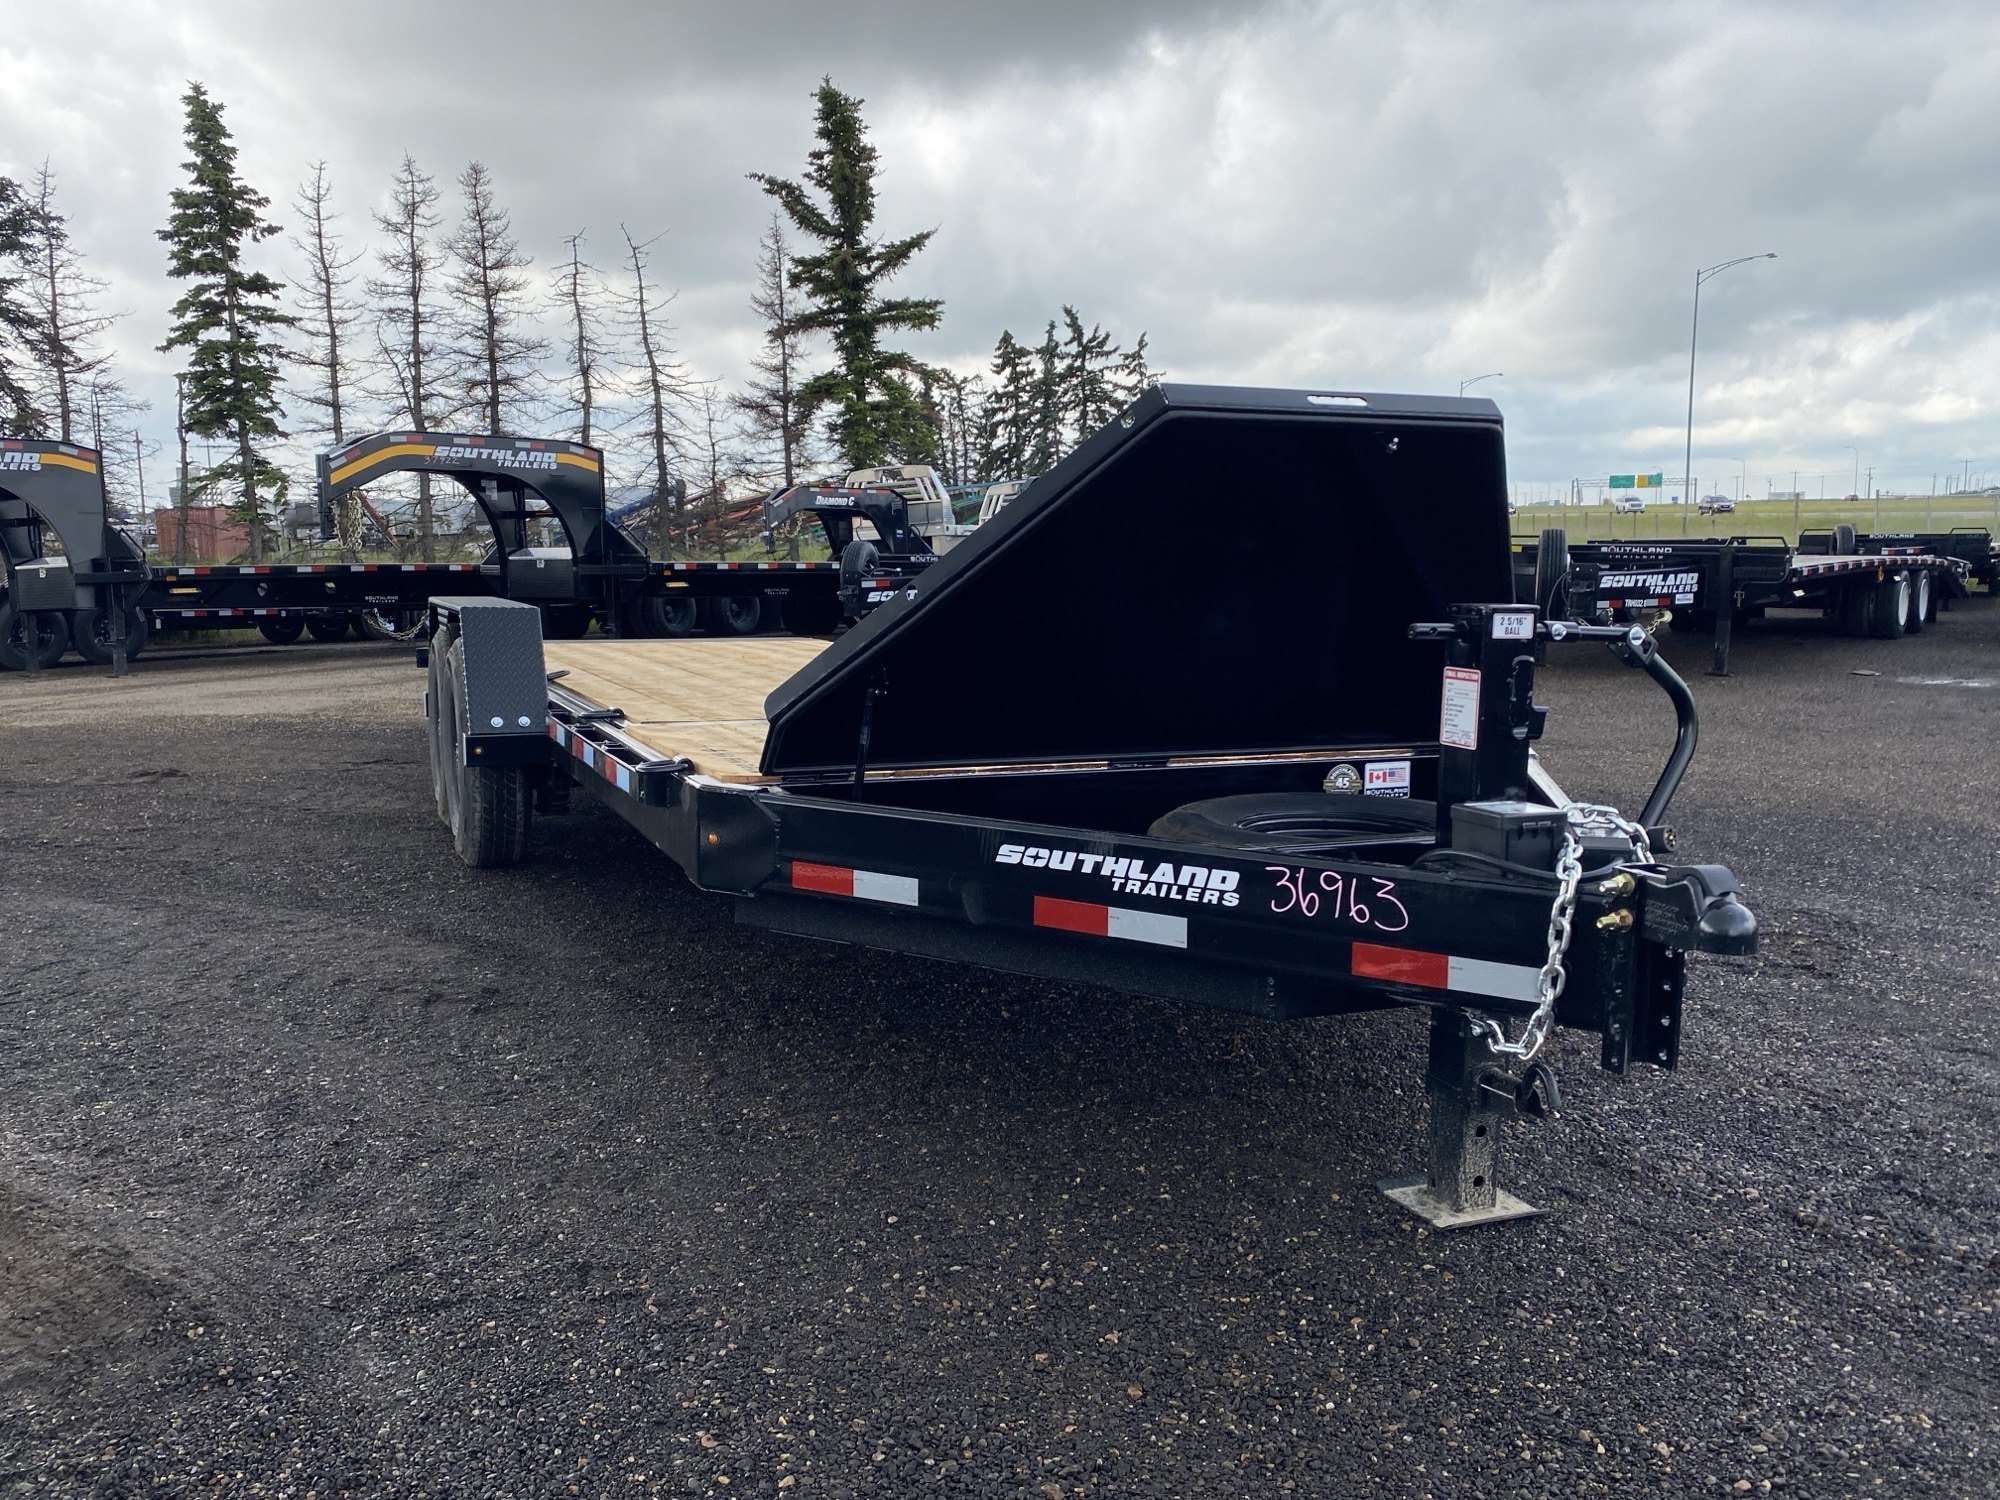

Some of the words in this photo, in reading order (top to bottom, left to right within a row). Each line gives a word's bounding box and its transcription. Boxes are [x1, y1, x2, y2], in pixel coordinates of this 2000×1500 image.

[0, 452, 41, 463] ND
[434, 446, 557, 463] SOUTHLAND
[496, 460, 558, 470] TRAILERS
[1600, 545, 1673, 554] SOUTHLAND
[910, 554, 938, 563] SOUTH
[1599, 572, 1699, 588] SOUTHLAND
[1649, 583, 1699, 595] TRAILERS
[1500, 616, 1506, 626] 2
[1505, 626, 1520, 635] BALL
[1335, 777, 1350, 789] 45
[995, 844, 1241, 891] SOUTHLAND
[1111, 878, 1240, 907] TRAILERS
[1265, 866, 1409, 931] 36963
